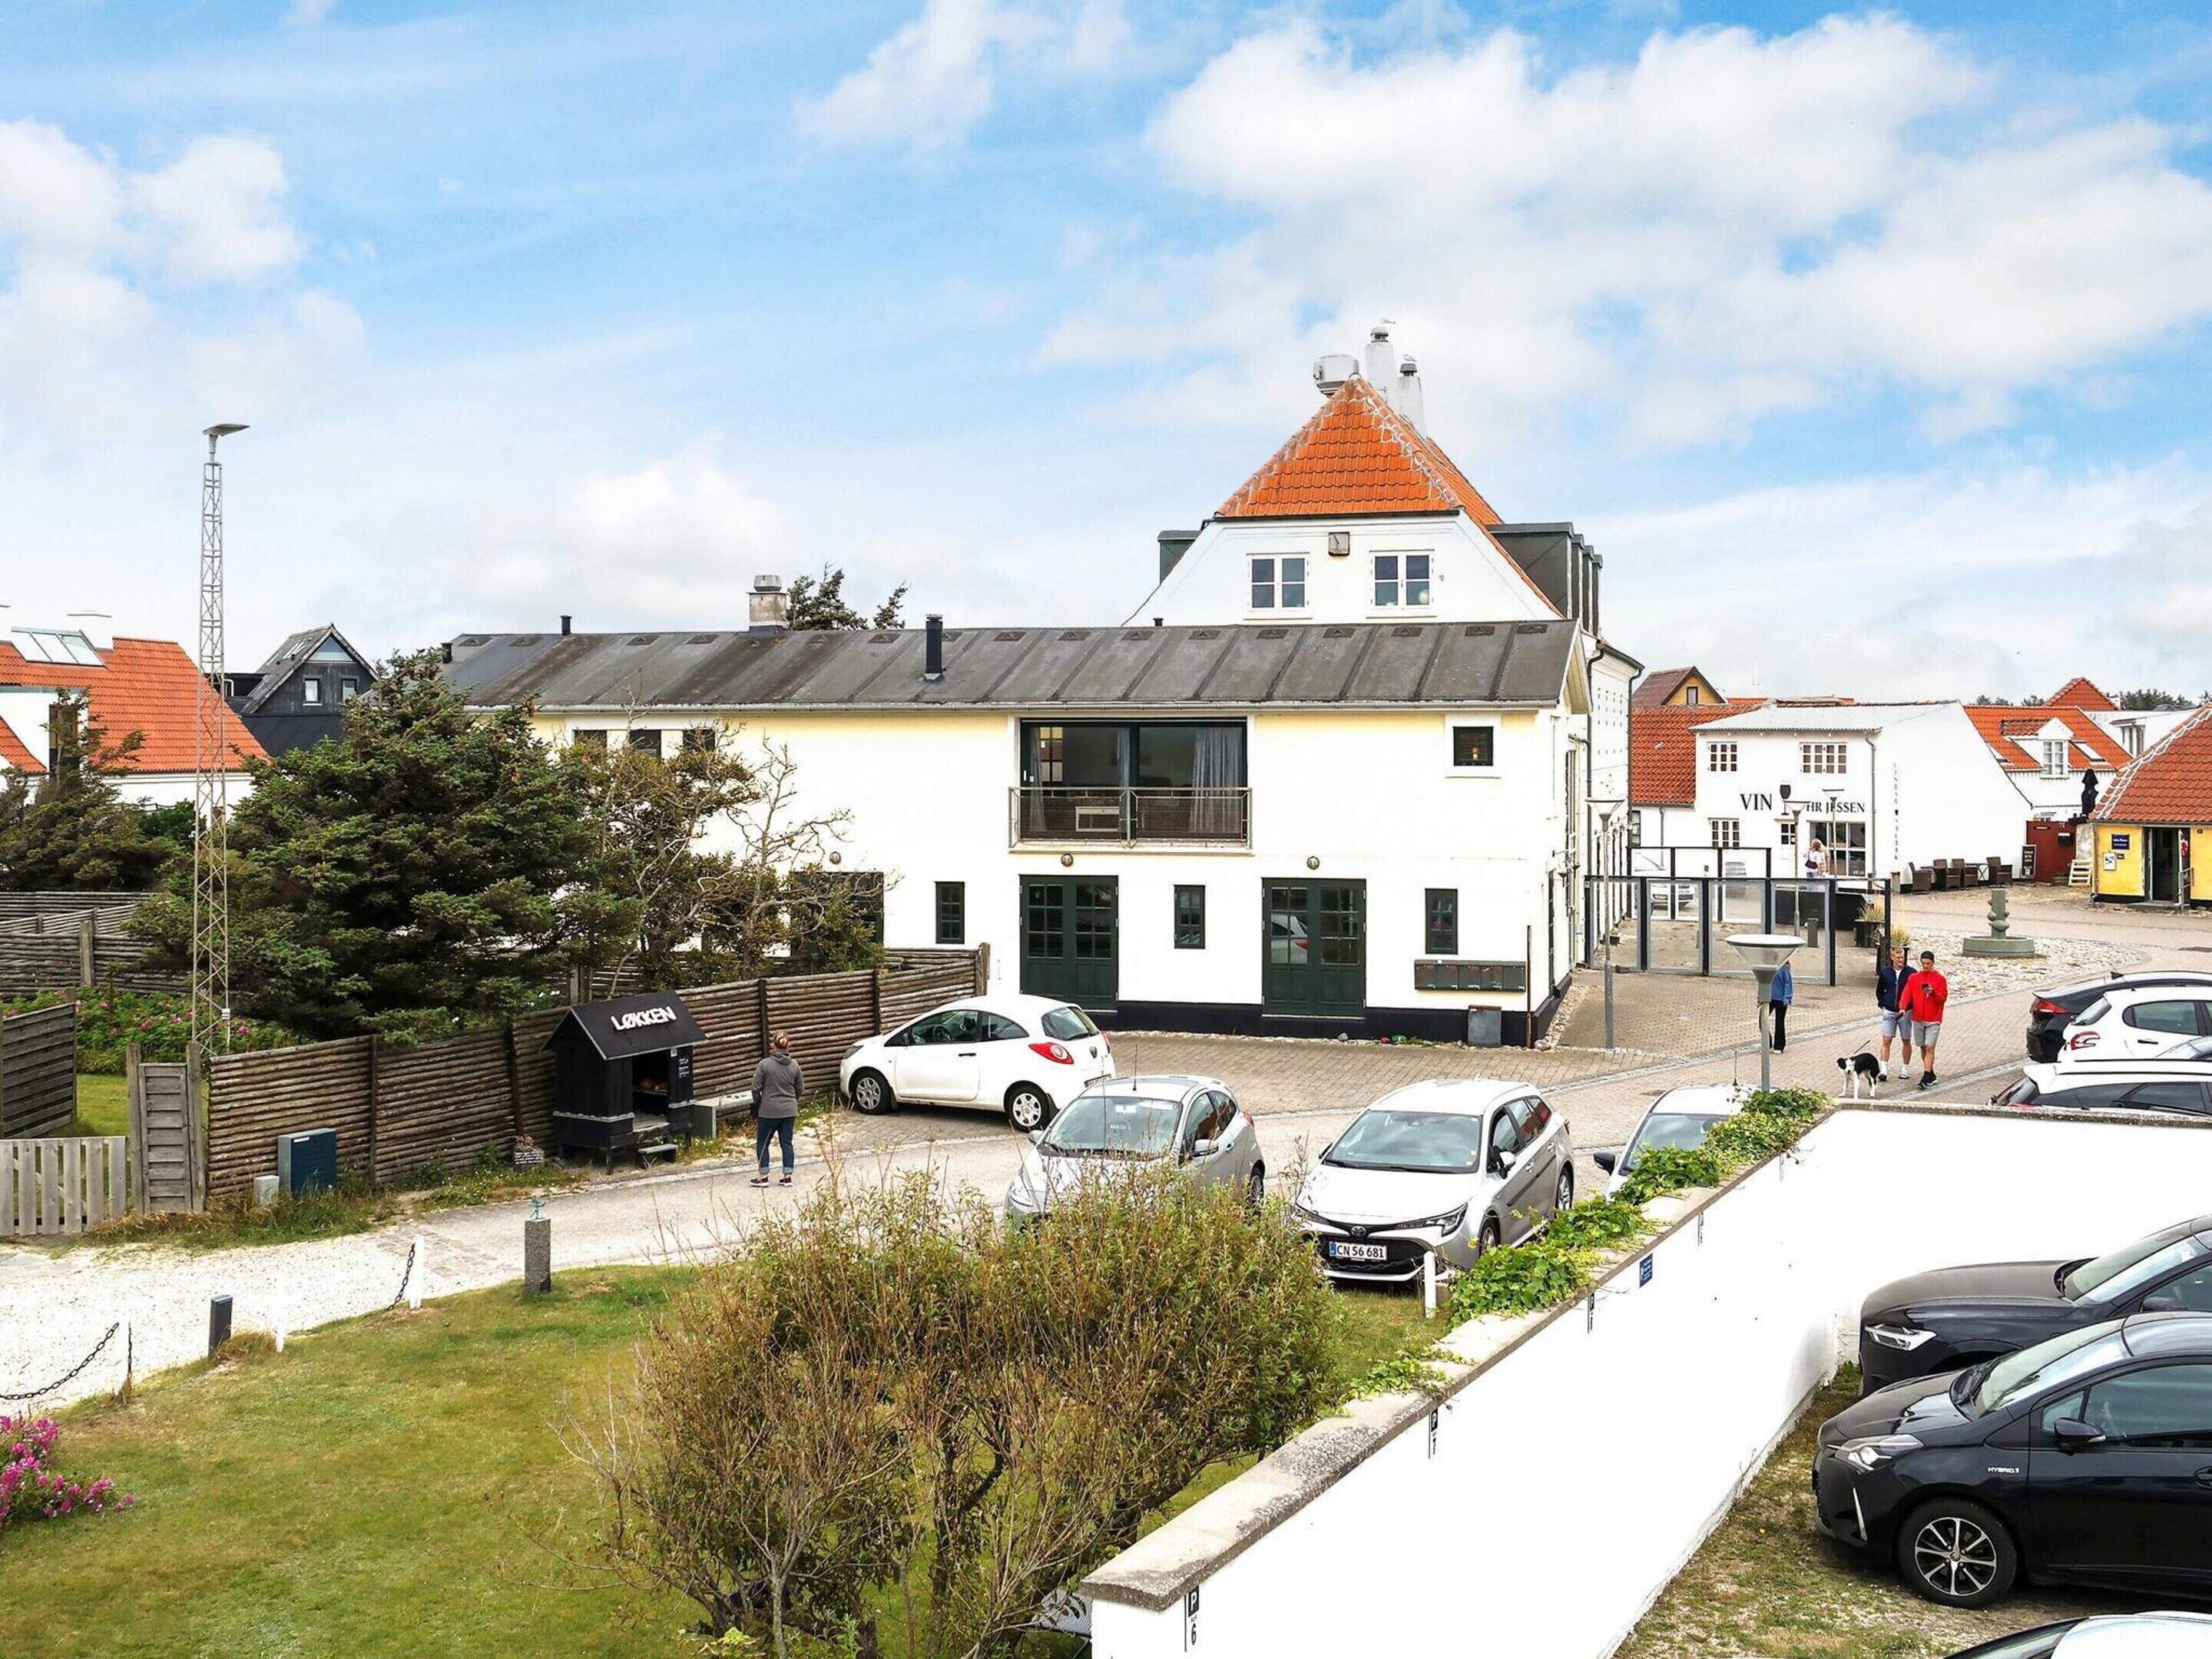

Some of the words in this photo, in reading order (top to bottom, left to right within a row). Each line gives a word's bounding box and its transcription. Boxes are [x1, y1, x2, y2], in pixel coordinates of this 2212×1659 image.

[1740, 793, 1772, 810] VIN
[611, 1005, 677, 1031] LØKKEN
[1337, 1245, 1350, 1256] CN
[1353, 1246, 1364, 1257] 56
[1366, 1247, 1384, 1258] 681
[1190, 1591, 1197, 1611] P
[1191, 1623, 1197, 1645] 6
